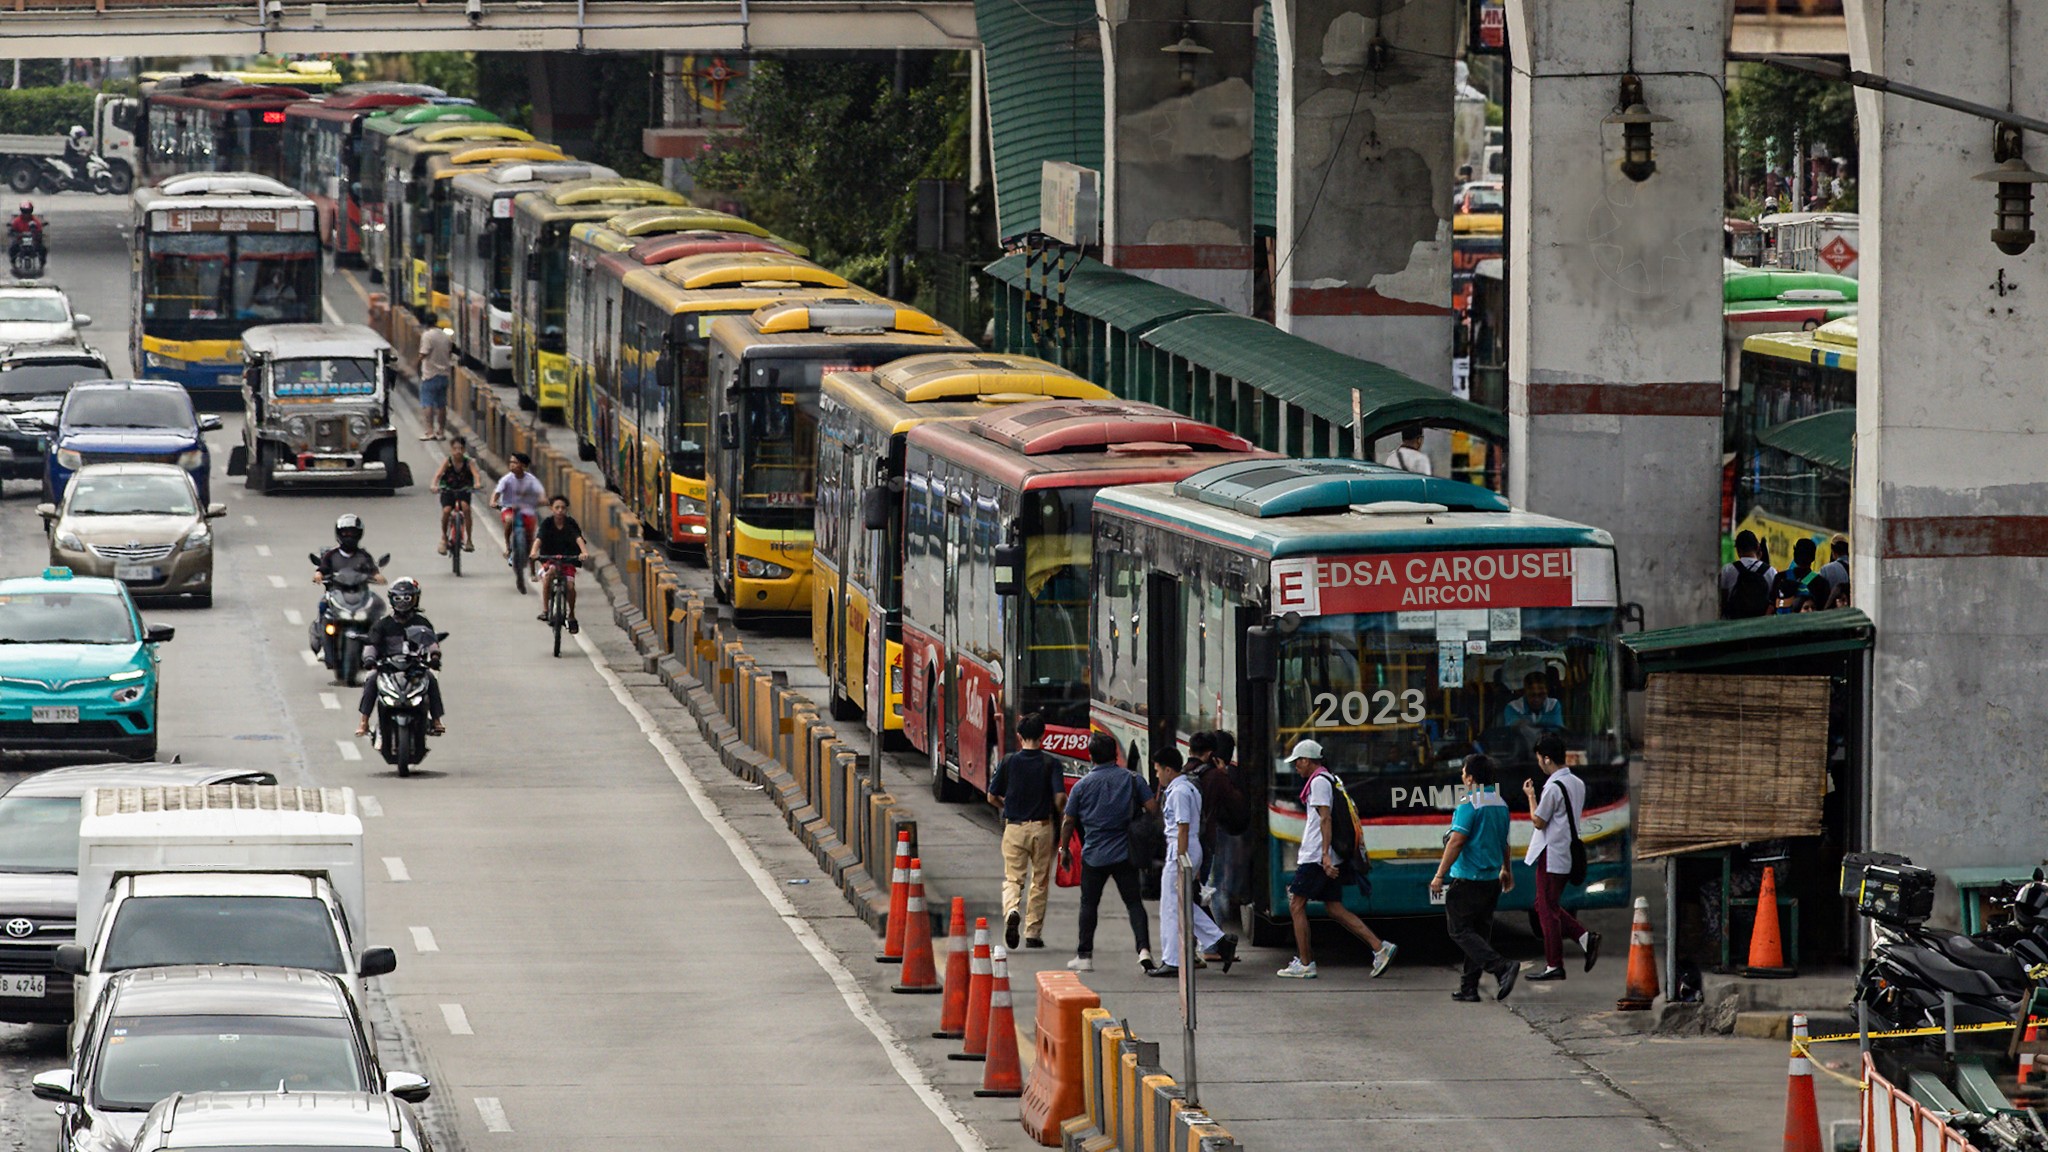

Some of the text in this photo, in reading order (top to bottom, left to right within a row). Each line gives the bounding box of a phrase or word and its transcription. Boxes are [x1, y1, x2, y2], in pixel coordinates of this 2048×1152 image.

[192, 210, 219, 221] EDSA
[221, 210, 275, 223] CAROUSEL
[1279, 552, 1577, 606] E EDSA CAROUSEL
[1401, 584, 1491, 606] AIRCON
[1314, 689, 1427, 727] 2023
[1042, 734, 1092, 750] 47193
[16, 979, 44, 992] 4746
